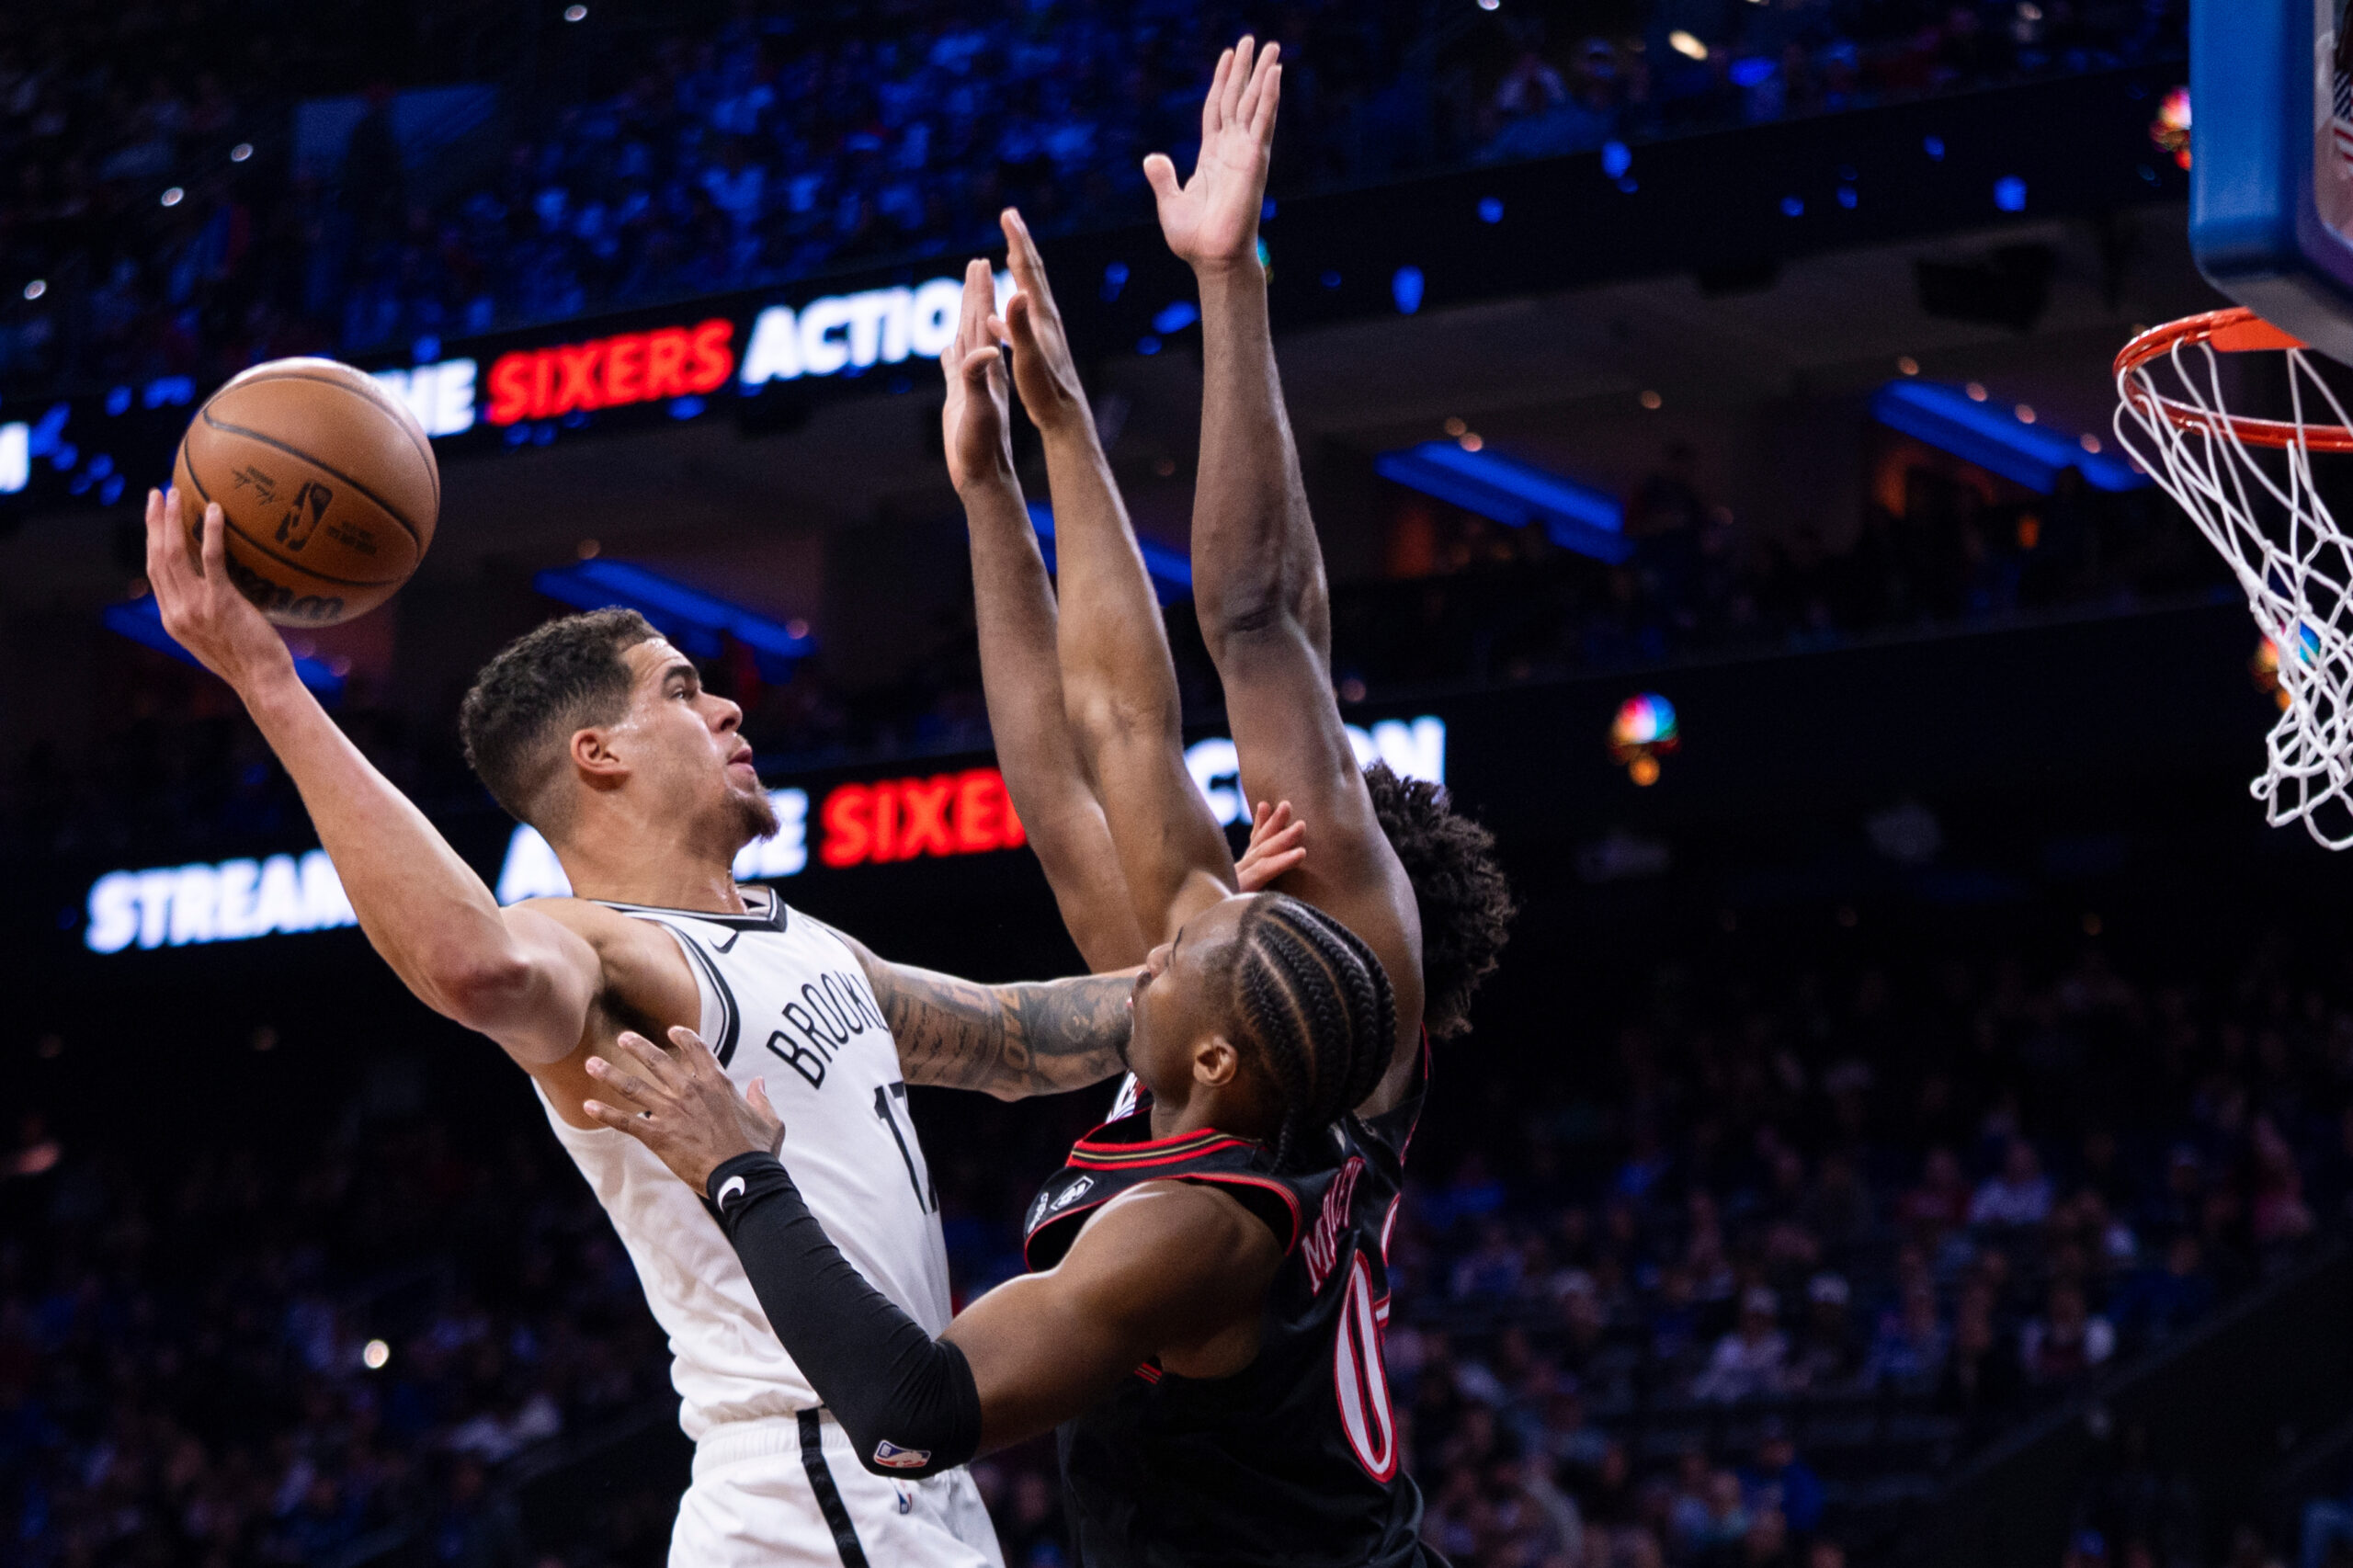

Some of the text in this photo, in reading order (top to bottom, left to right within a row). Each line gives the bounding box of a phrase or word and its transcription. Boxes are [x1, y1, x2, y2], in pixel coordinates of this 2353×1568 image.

[369, 270, 1018, 438] HE SIXERS ACTIO
[766, 970, 891, 1090] BROOKL
[1334, 1247, 1399, 1484] 0
